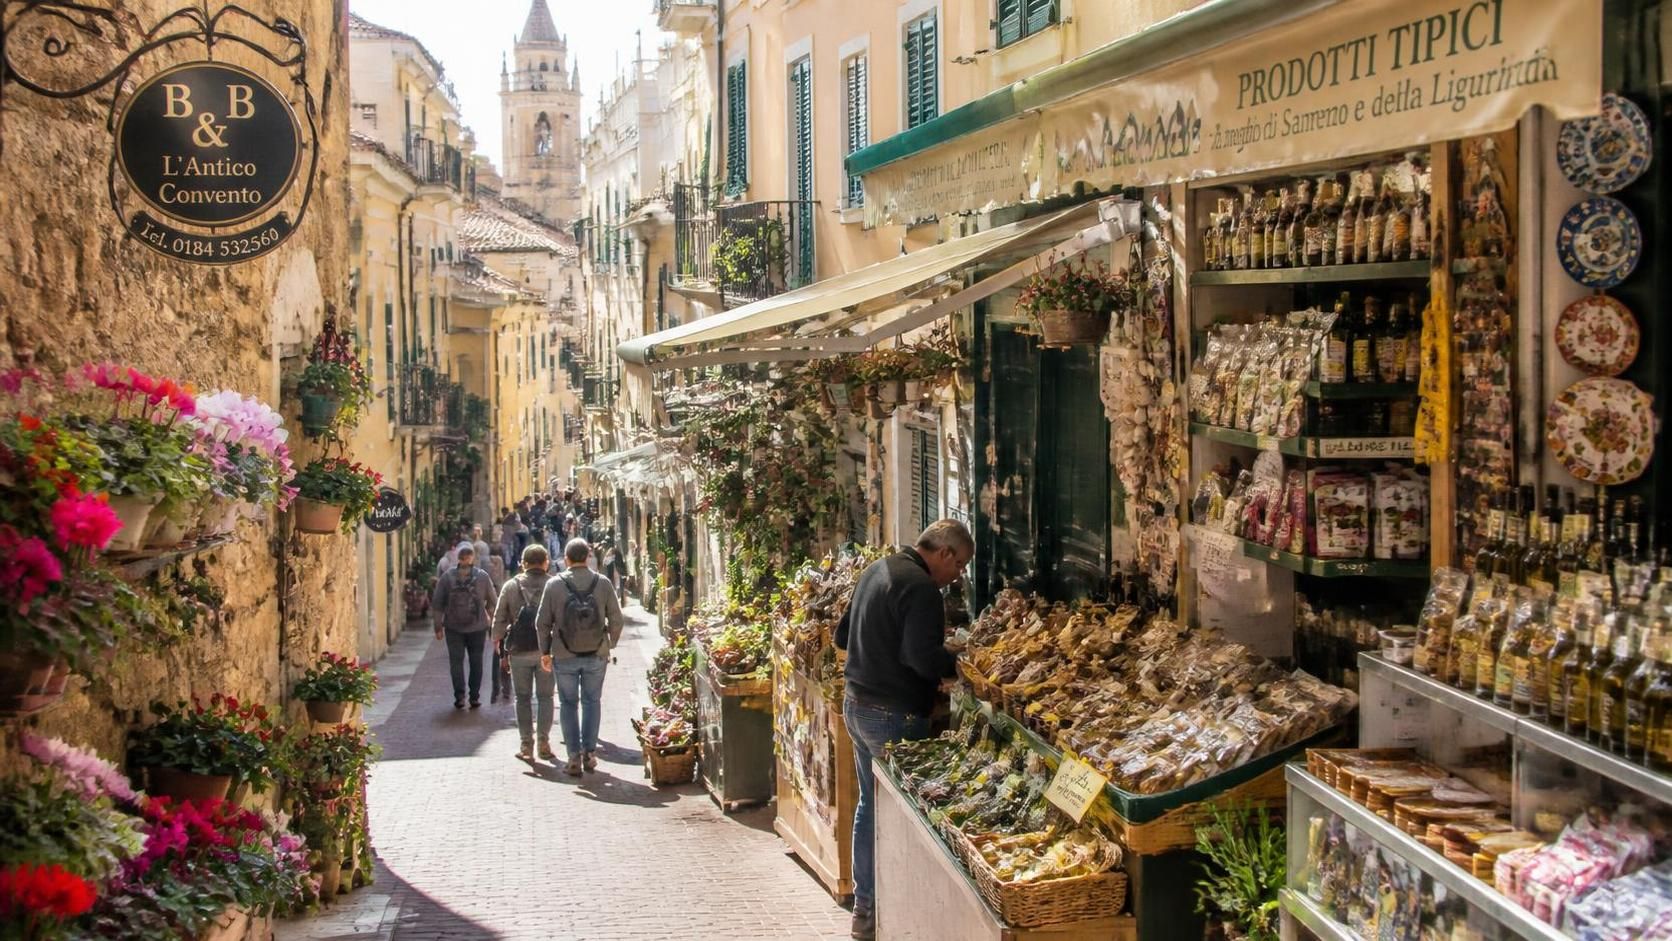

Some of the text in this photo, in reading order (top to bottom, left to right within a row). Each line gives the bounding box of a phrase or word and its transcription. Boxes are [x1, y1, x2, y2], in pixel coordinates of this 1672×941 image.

[1236, 0, 1504, 110] PRODOTTI TIPICI
[162, 84, 255, 148] B & B
[1355, 100, 1366, 122] e
[1371, 78, 1423, 117] della
[162, 155, 256, 177] L'Antico
[159, 183, 261, 204] Convento
[173, 238, 214, 257] 0184
[220, 227, 279, 257] 532560
